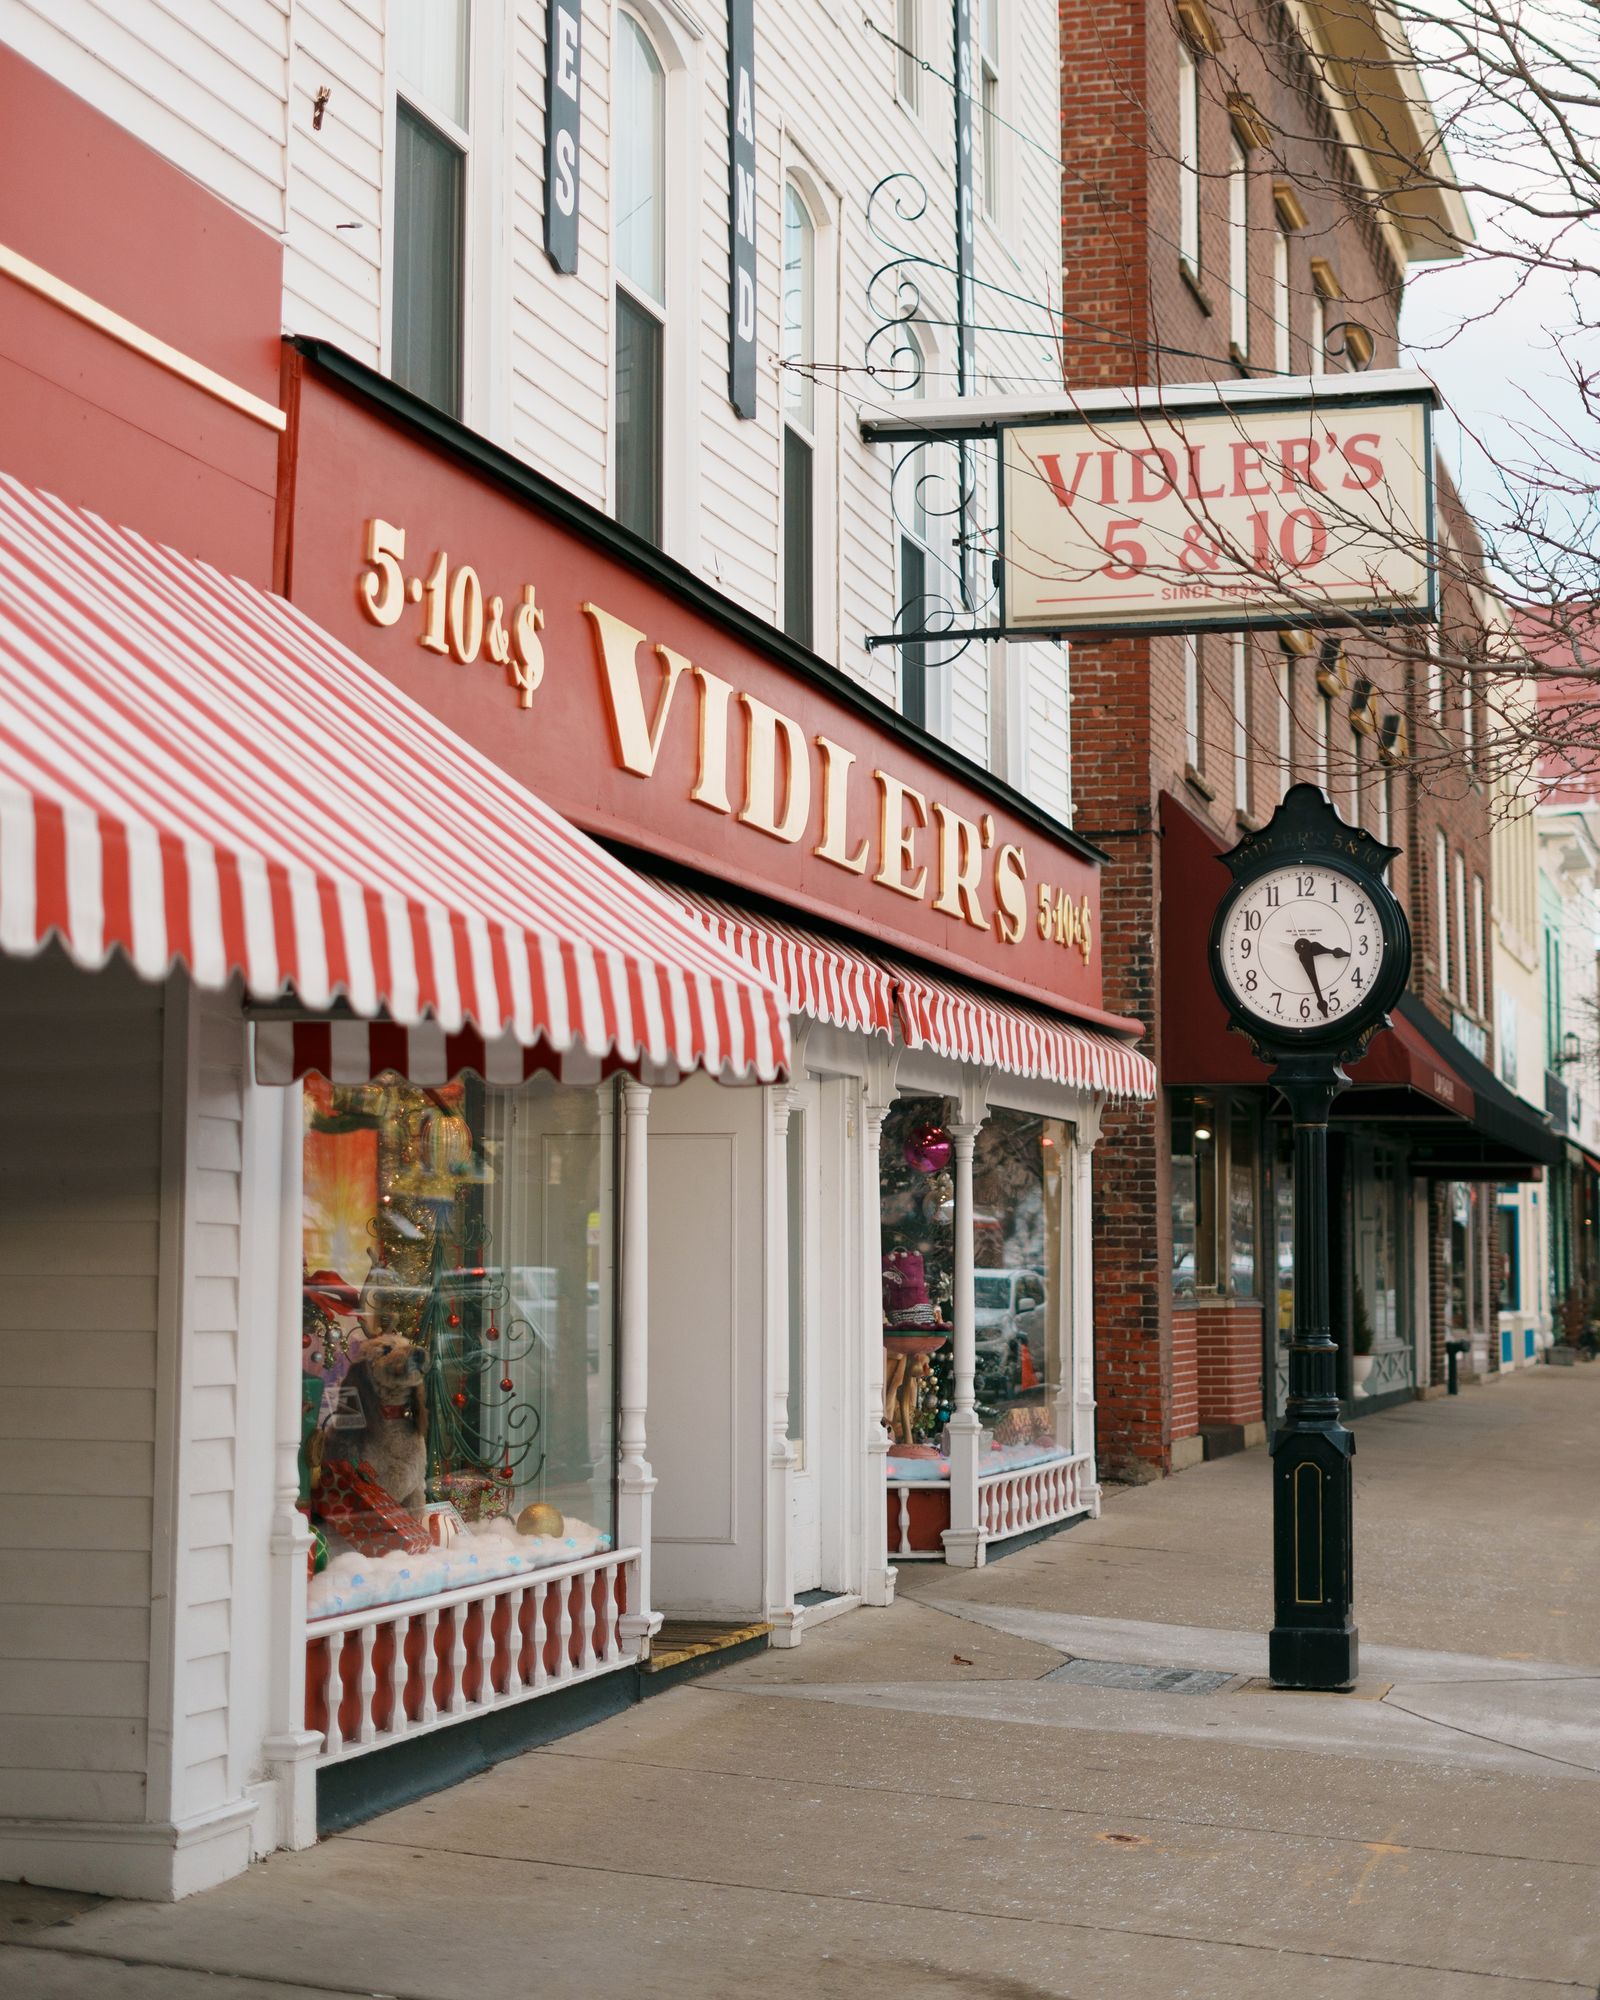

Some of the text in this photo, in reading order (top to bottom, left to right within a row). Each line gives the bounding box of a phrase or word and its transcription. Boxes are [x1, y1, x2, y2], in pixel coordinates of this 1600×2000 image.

[737, 66, 755, 343] AND
[1037, 432, 1384, 508] VIDLER'S
[1099, 507, 1328, 580] 5 & 10
[1161, 585, 1213, 601] SINCE
[582, 602, 1028, 945] VIDLER'S
[1266, 886, 1281, 907] 11
[1296, 876, 1316, 896] 12
[1331, 882, 1339, 903] 1
[1244, 910, 1262, 931] 10
[1354, 904, 1367, 924] 2
[1241, 939, 1252, 959] 9
[1359, 935, 1369, 955] 3
[1245, 970, 1259, 991] 8
[1351, 967, 1364, 988] 4
[1269, 993, 1285, 1014] 7
[1299, 998, 1311, 1018] 6
[1328, 990, 1341, 1012] 5
